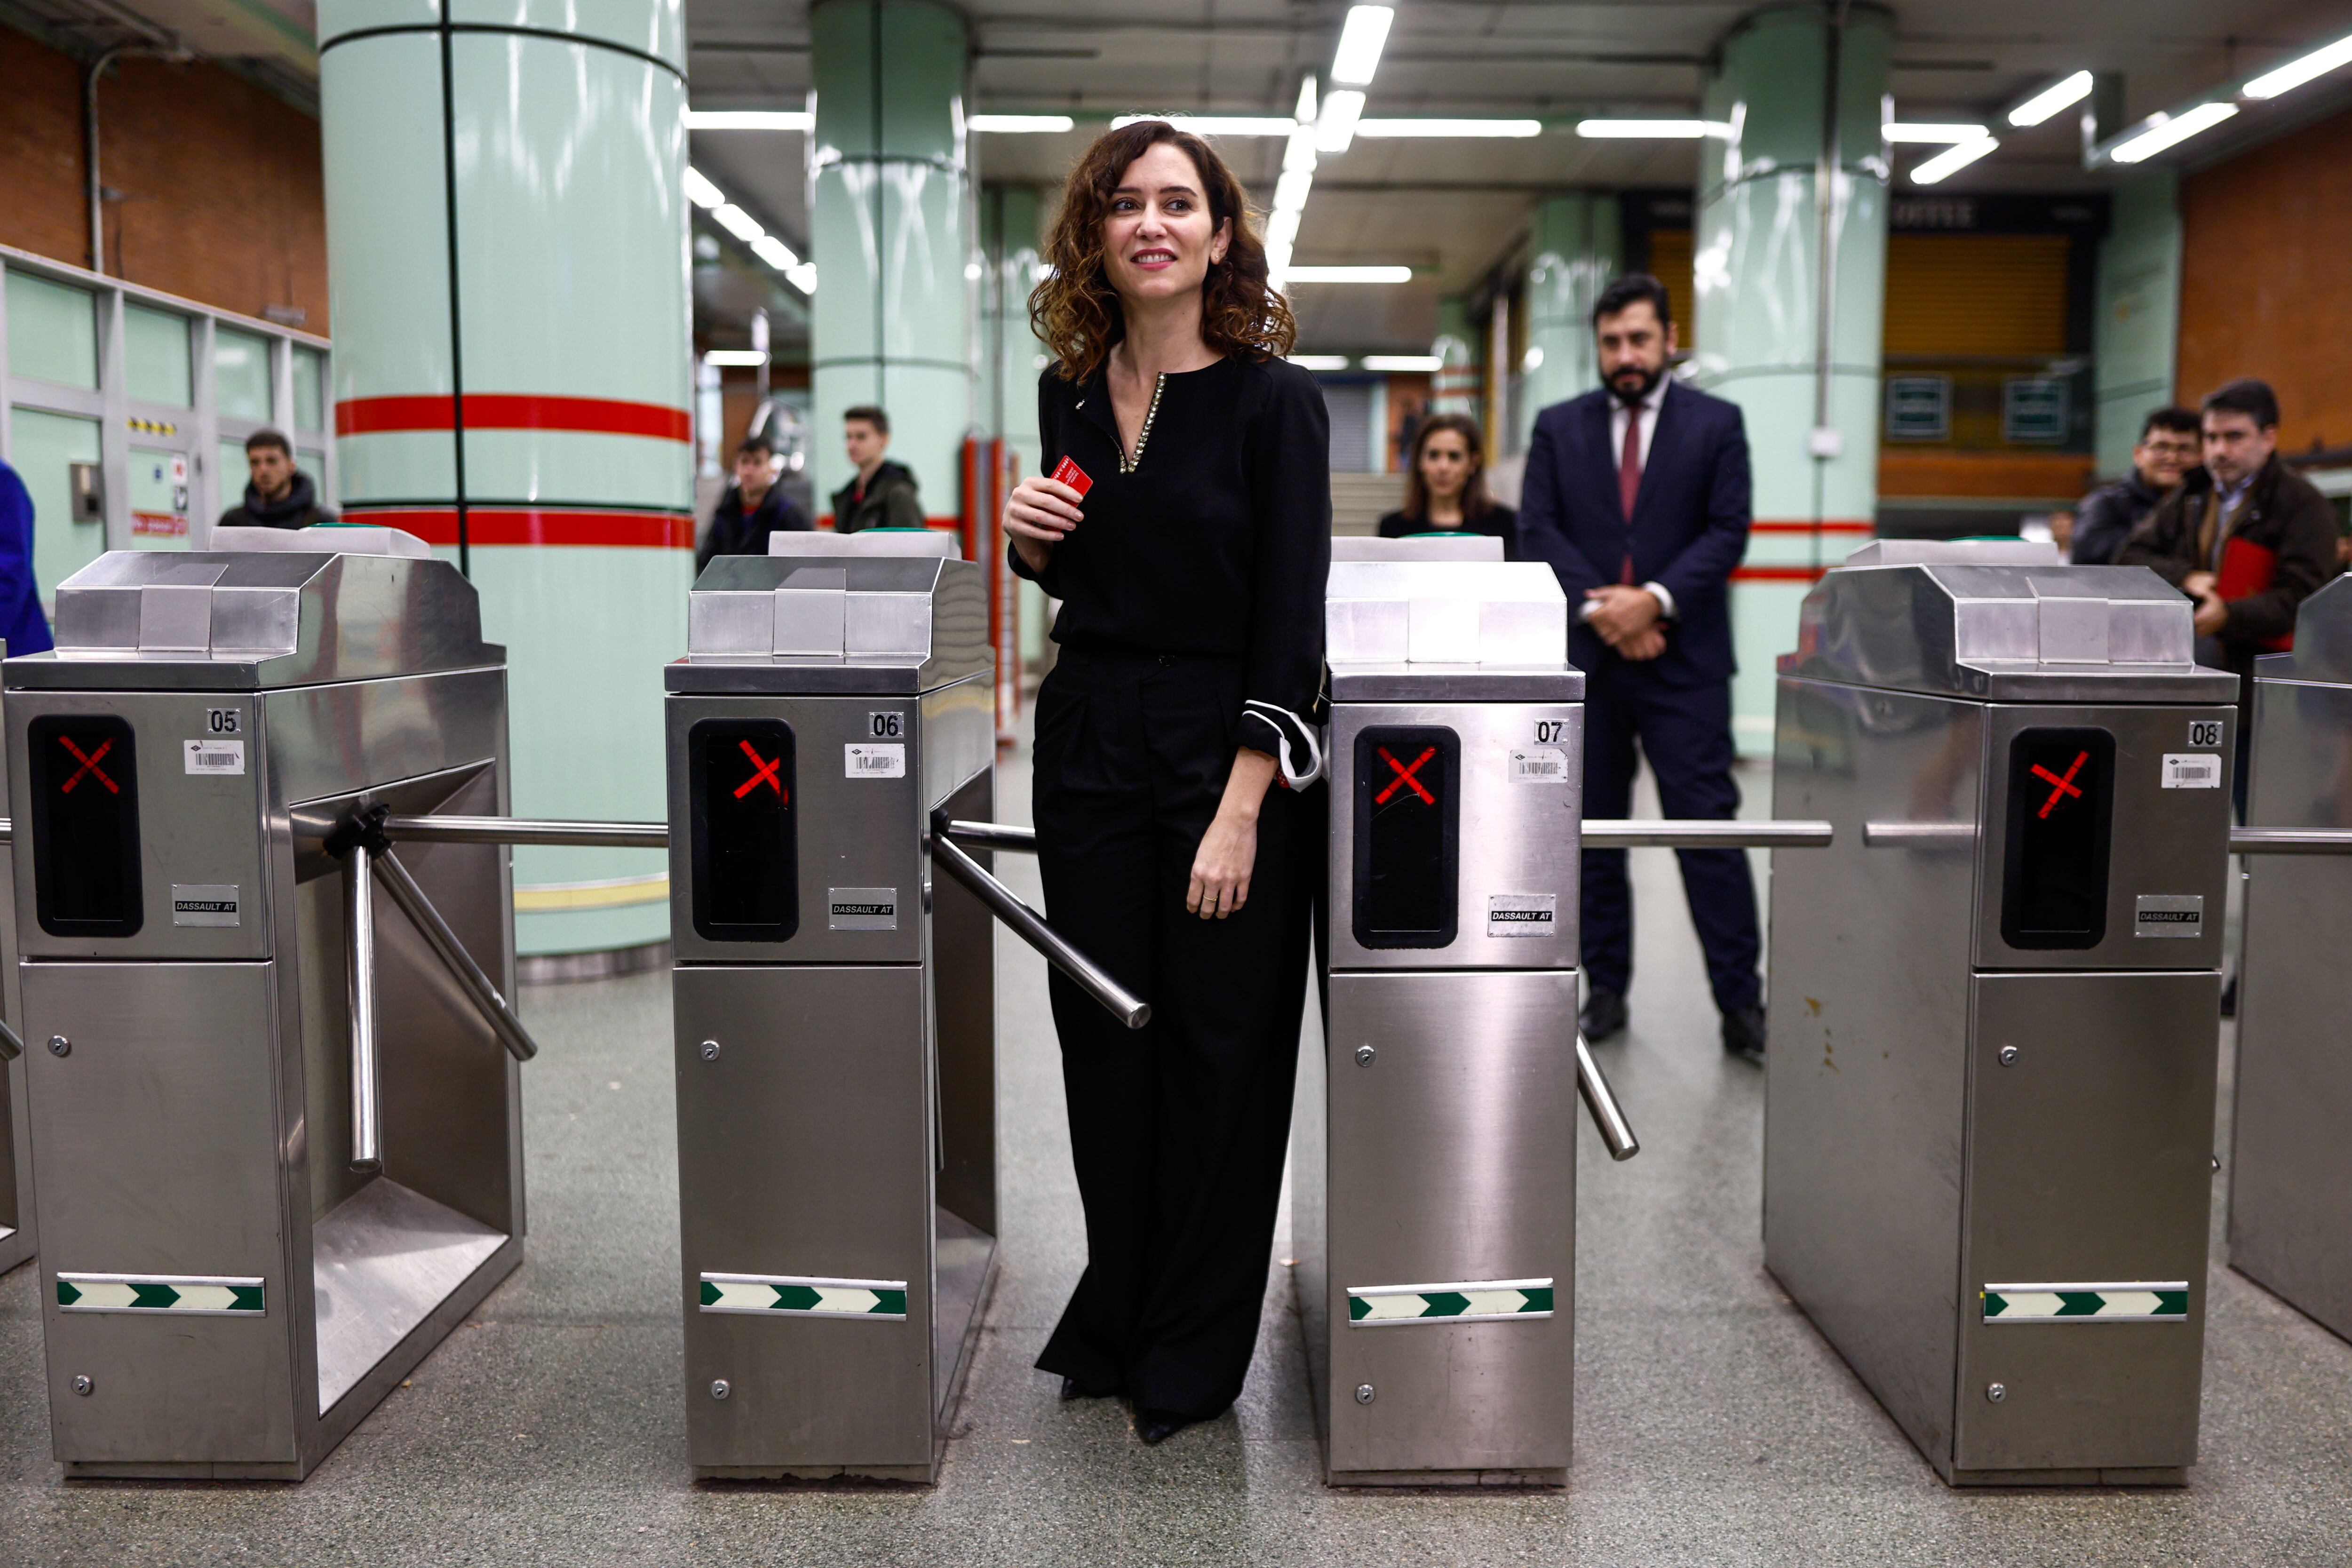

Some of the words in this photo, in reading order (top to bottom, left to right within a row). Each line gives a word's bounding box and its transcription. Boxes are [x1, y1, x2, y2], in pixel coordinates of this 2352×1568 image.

[1065, 470, 1076, 485] transport
[211, 710, 237, 732] 05
[874, 714, 898, 736] 06
[1538, 721, 1563, 742] 07
[2193, 724, 2217, 745] 08
